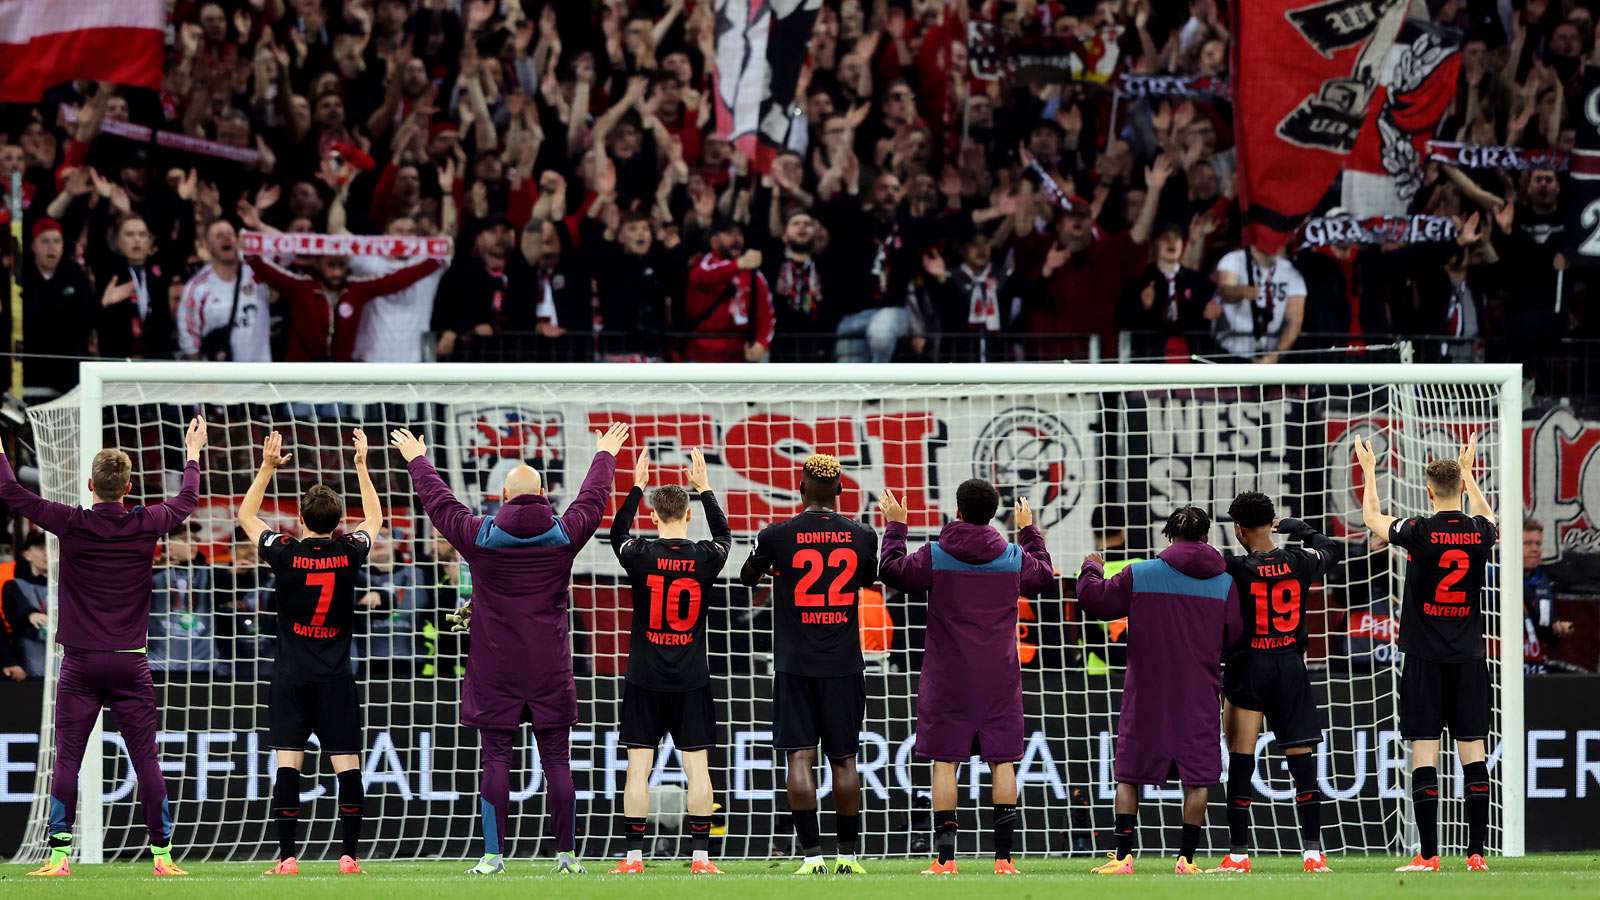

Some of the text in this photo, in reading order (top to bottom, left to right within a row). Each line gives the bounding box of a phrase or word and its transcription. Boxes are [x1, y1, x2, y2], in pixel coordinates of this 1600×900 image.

[1148, 399, 1293, 456] WEST
[1149, 458, 1292, 518] SIDE
[292, 555, 350, 570] HOFMANN
[796, 531, 853, 544] BONIFACE
[1430, 531, 1482, 545] STANISIC
[656, 558, 696, 572] WIRTZ
[791, 547, 858, 607] 22
[1256, 562, 1292, 577] TELLA
[1435, 549, 1470, 604] 2
[305, 572, 336, 626] 7
[646, 574, 702, 631] 10
[1250, 578, 1302, 635] 19
[293, 622, 340, 639] BAYER0
[78, 731, 460, 802] FIAL
[734, 731, 1068, 800] EROA
[1098, 731, 1408, 800] LGUE
